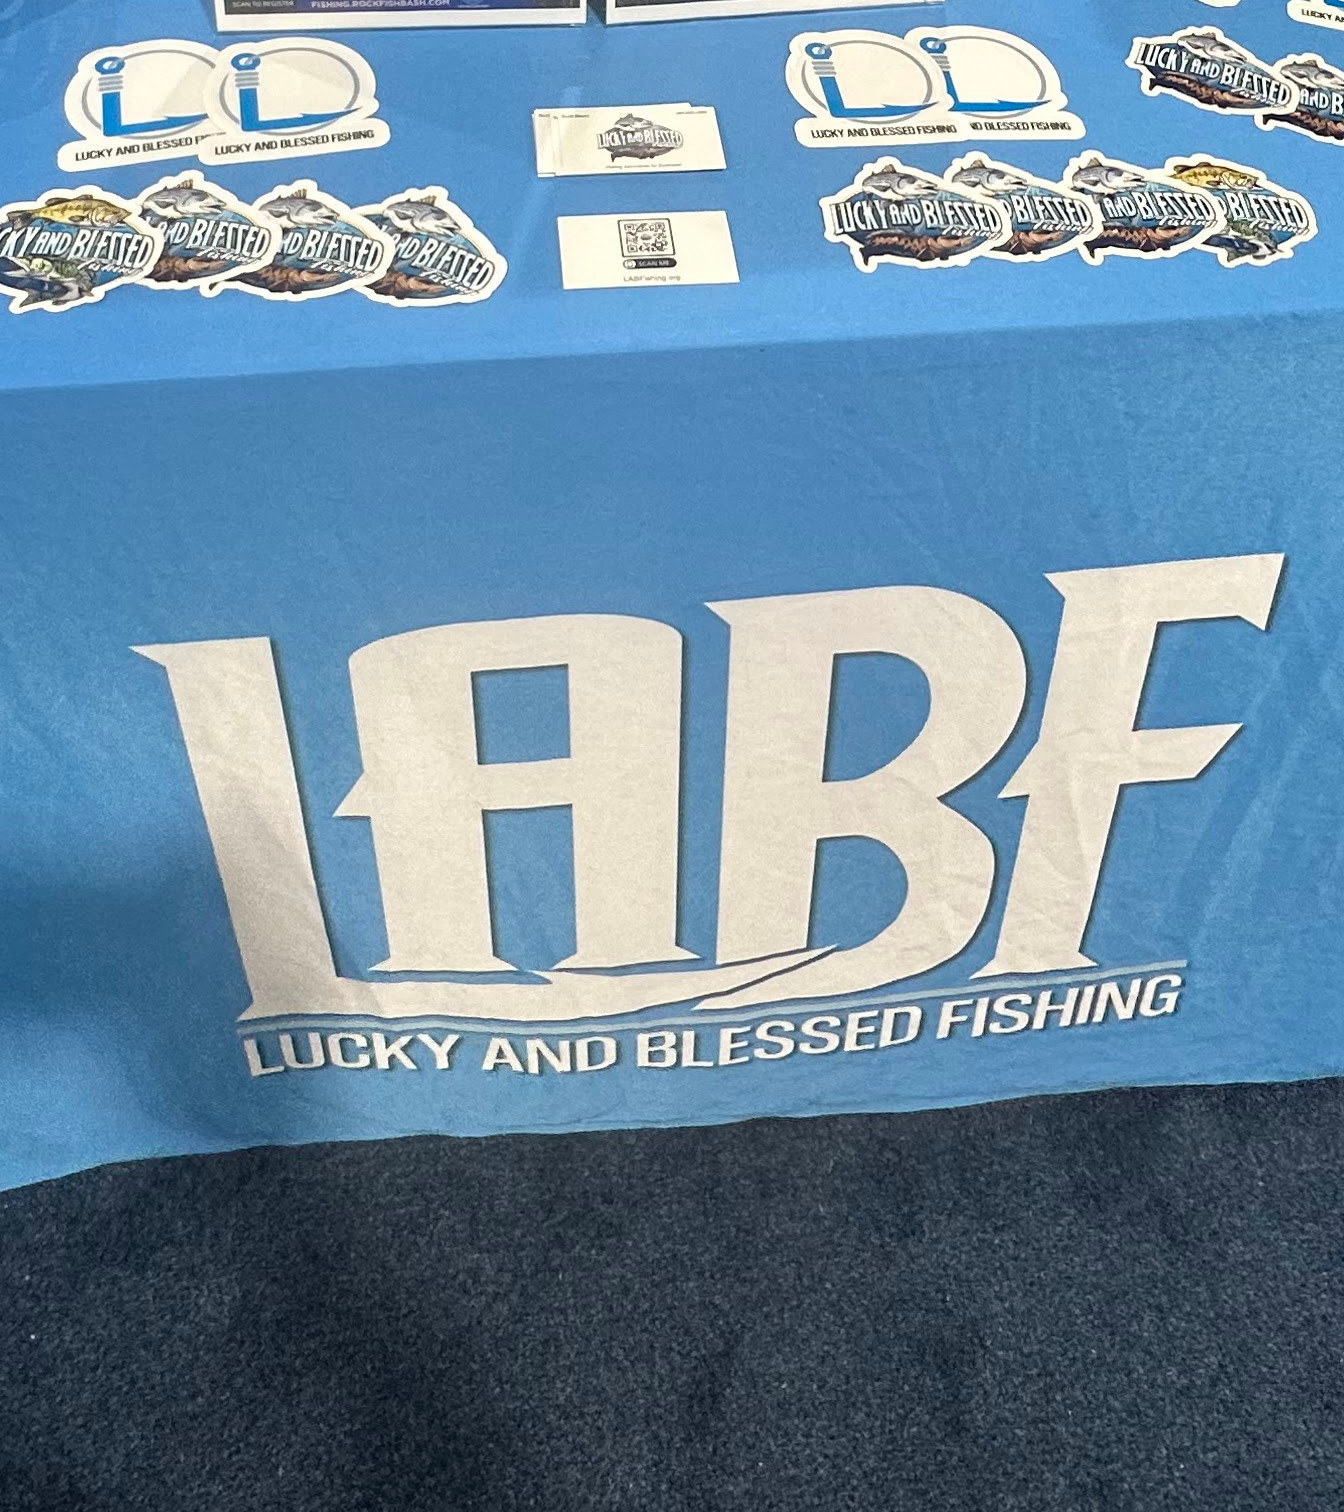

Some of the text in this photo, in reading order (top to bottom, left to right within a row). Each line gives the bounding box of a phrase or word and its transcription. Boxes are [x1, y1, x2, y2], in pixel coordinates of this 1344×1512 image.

[1136, 43, 1292, 107] LUCKY AND BLESSED
[214, 129, 375, 156] LUCKY AND BLESSED FISHING
[811, 124, 957, 140] LUCKY AND BLESSED FISHING
[831, 194, 1003, 235] LUCKY AND BLESSED
[37, 231, 71, 257] AND
[72, 228, 157, 268] BLESSED
[128, 552, 1286, 1020] LABF
[247, 973, 1183, 1077] LUCKY AND BLESSED FISHING
